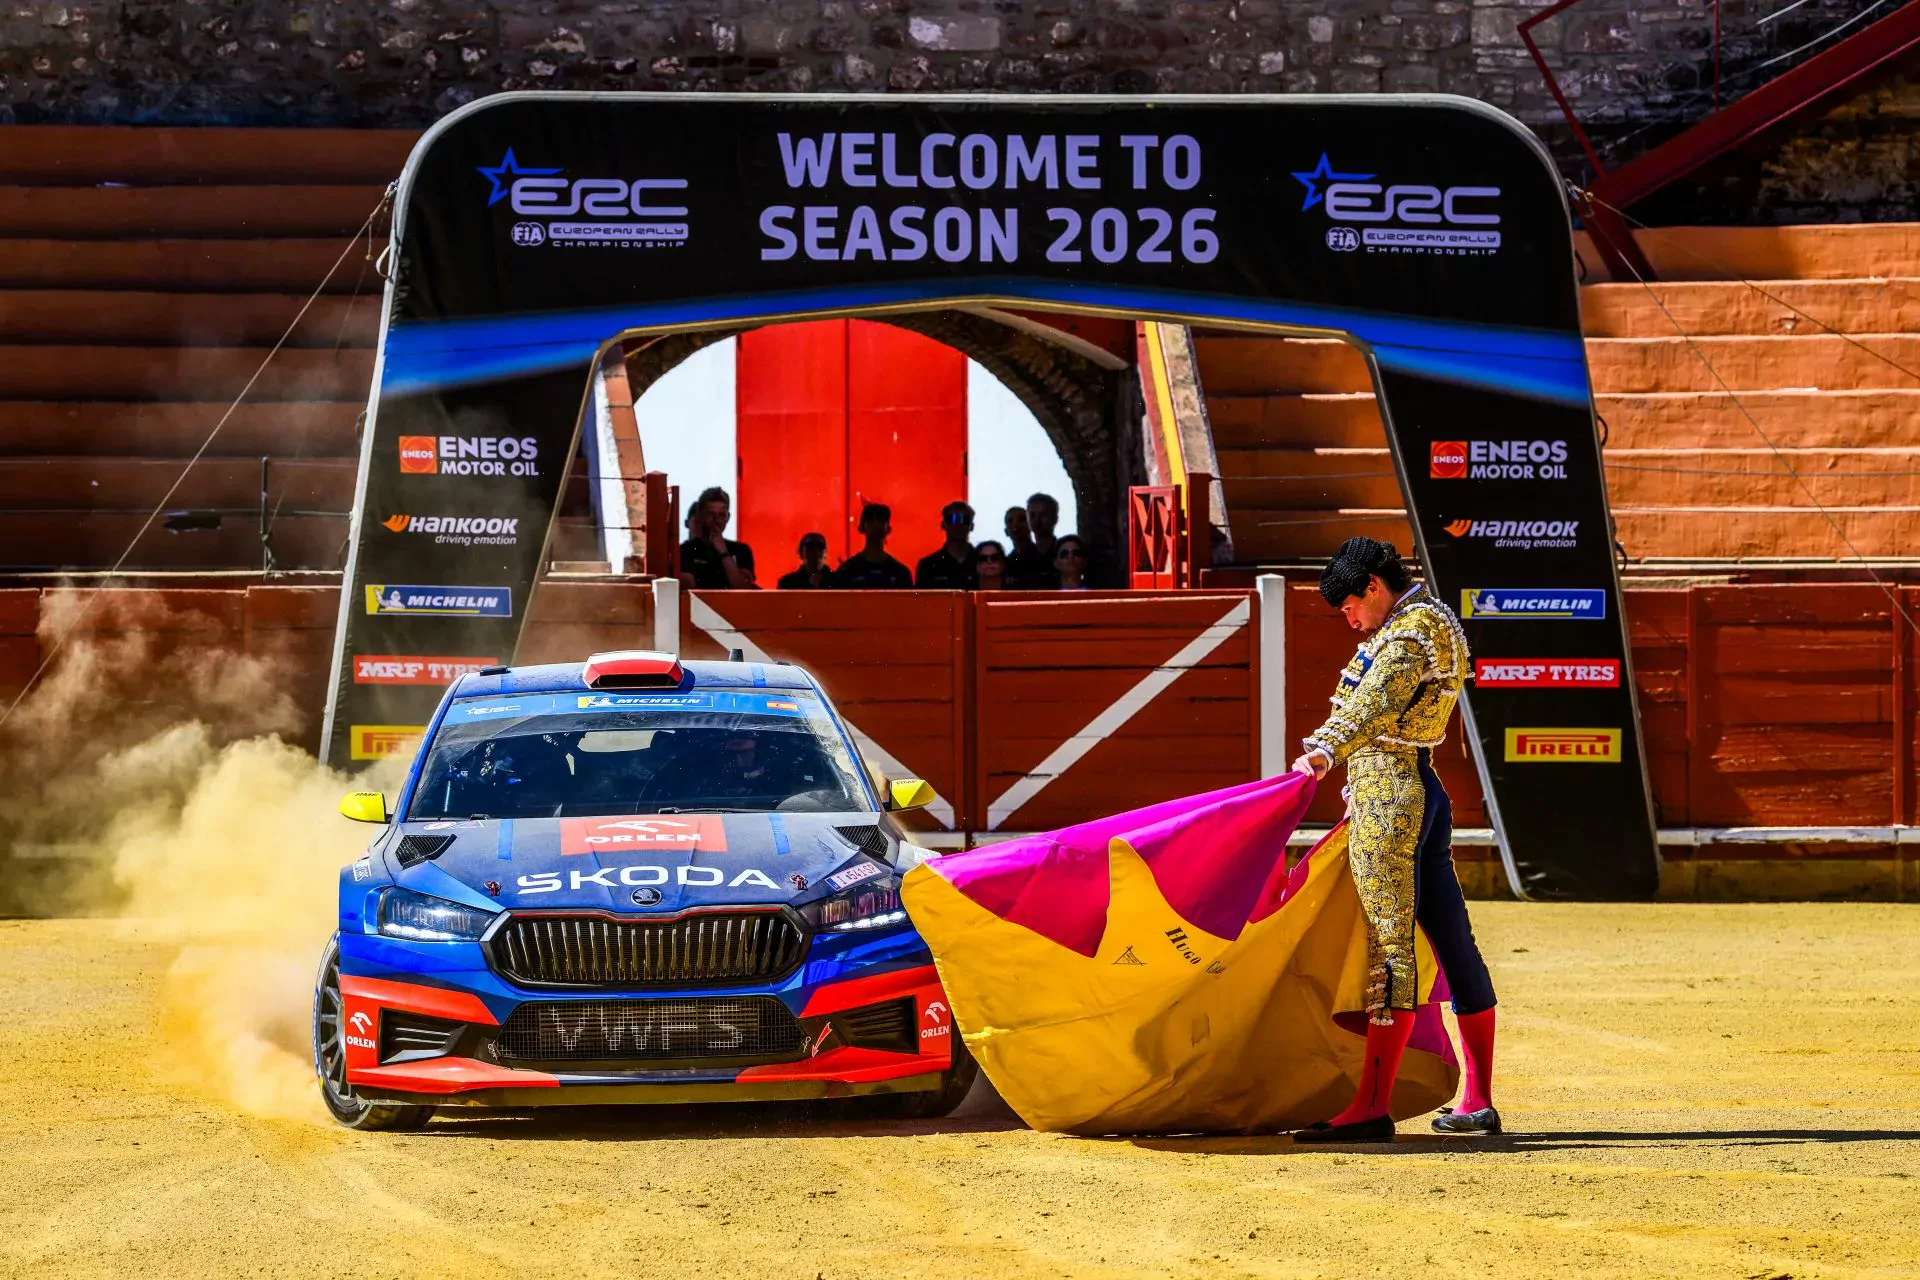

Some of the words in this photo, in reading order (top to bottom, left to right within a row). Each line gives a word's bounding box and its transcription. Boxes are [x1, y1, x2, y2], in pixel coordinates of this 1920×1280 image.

[777, 132, 1101, 189] WELCOME
[1120, 134, 1201, 190] TO
[511, 178, 688, 216] ERC
[1326, 183, 1501, 224] ERC
[552, 226, 633, 235] EUROPEAN
[635, 227, 684, 235] RALLY
[758, 205, 1019, 263] SEASON
[1045, 207, 1220, 264] 2026
[1366, 232, 1446, 241] EUROPEAN
[1449, 235, 1497, 243] RALLY
[552, 240, 685, 248] CHAMPIONSHIP
[1367, 246, 1497, 255] CHAMPIONSHIP
[402, 450, 434, 459] ENEOS
[439, 436, 538, 459] ENEOS
[1470, 440, 1568, 463] ENEOS
[1433, 456, 1465, 464] ENEOS
[441, 461, 506, 476] MOTOR
[510, 462, 539, 476] OIL
[1470, 465, 1534, 479] MOTOR
[1539, 465, 1567, 479] OIL
[434, 534, 471, 546] driving
[473, 535, 517, 545] emotion
[1495, 538, 1531, 550] driving
[1533, 539, 1576, 548] emotion
[407, 595, 499, 608] MICHELIN
[1502, 599, 1592, 610] MICHELIN
[358, 662, 424, 678] MRF
[1480, 665, 1545, 681] MRF
[1550, 665, 1614, 681] TYRES
[1516, 734, 1611, 756] PIRELLI
[584, 833, 702, 844] ORLEN
[548, 1005, 743, 1050] VWFS
[921, 1025, 949, 1039] ORLEN
[347, 1035, 376, 1049] ORLEN
